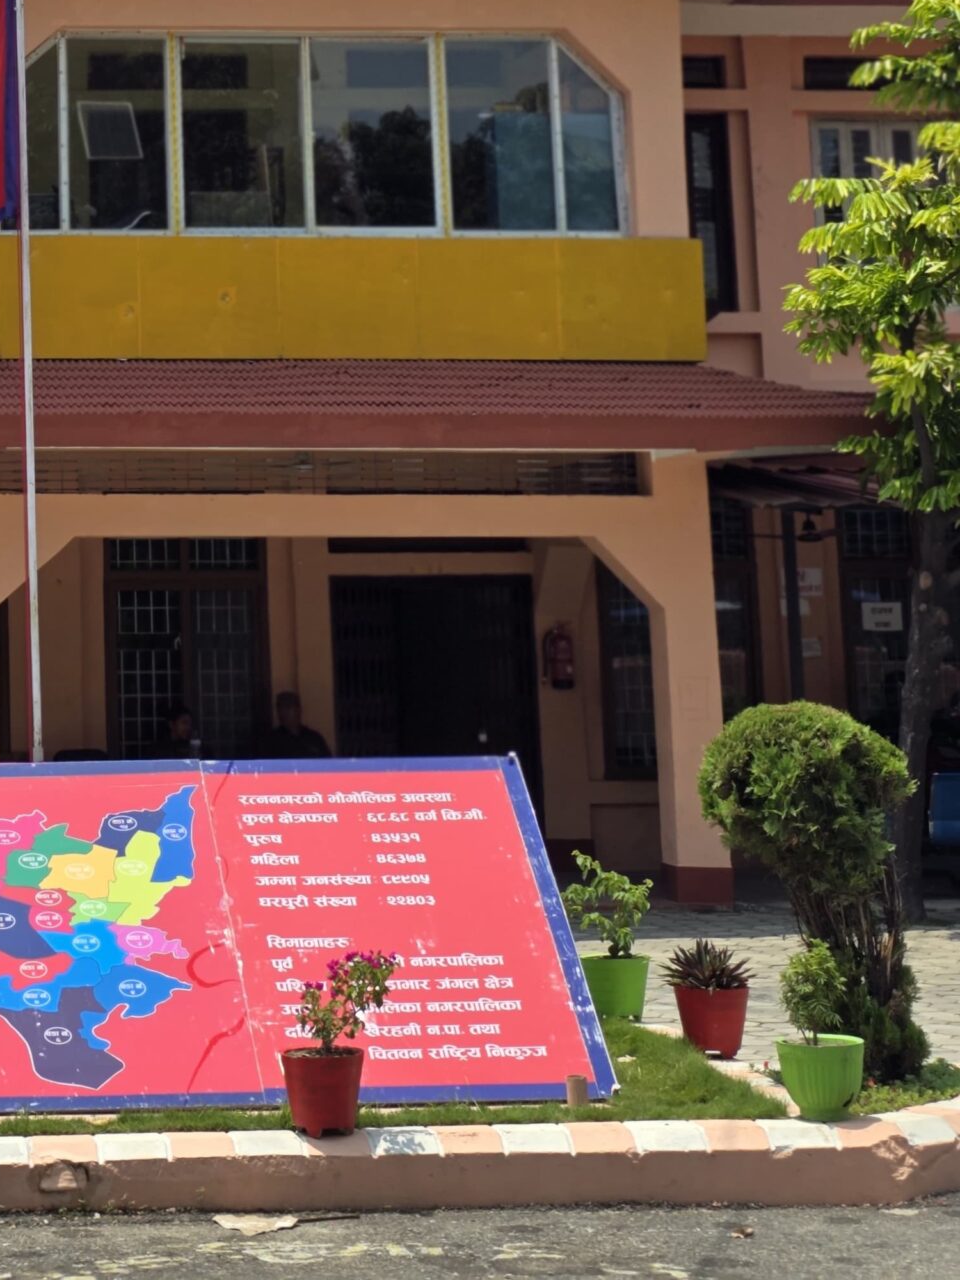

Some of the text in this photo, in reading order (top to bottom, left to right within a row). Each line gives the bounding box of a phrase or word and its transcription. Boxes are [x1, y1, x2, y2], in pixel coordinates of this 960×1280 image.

[238, 791, 324, 805] रत्ननगरको
[328, 791, 396, 804] भौगोलिक
[242, 814, 274, 826] कुल
[278, 811, 339, 824] क्षेत्रफल
[243, 832, 421, 847] पुरुष ४३५३१
[250, 852, 427, 866] महिला ४६३७४
[255, 876, 297, 886] जम्मा
[313, 894, 357, 908] संख्या
[271, 956, 293, 972] पूर्व
[410, 952, 504, 968] नगरपालिका
[435, 977, 479, 991] जंगल
[484, 974, 514, 990] क्षेत्र
[427, 997, 522, 1013] नगरपालिका
[469, 1023, 501, 1036] तथा
[368, 1046, 423, 1061] चितवन
